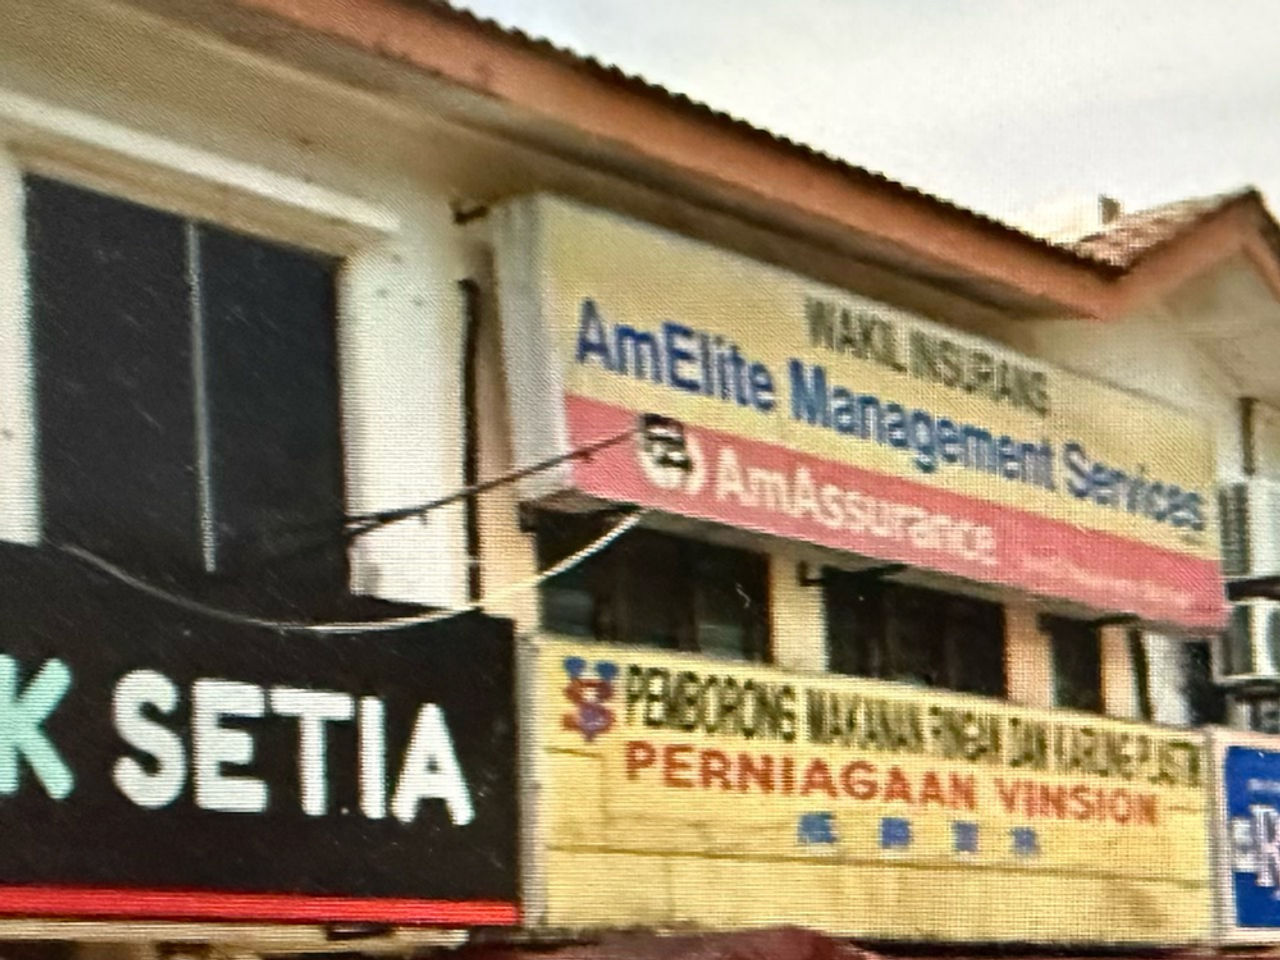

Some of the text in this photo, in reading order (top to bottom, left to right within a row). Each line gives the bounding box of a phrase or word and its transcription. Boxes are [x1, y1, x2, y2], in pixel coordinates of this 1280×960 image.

[576, 296, 1206, 531] AmElite Management Services
[713, 447, 999, 567] AmAssurance
[111, 669, 476, 826] SETIA
[624, 663, 797, 743] PEMBORONG
[623, 740, 1157, 826] PERNIAGAAN VINSION
